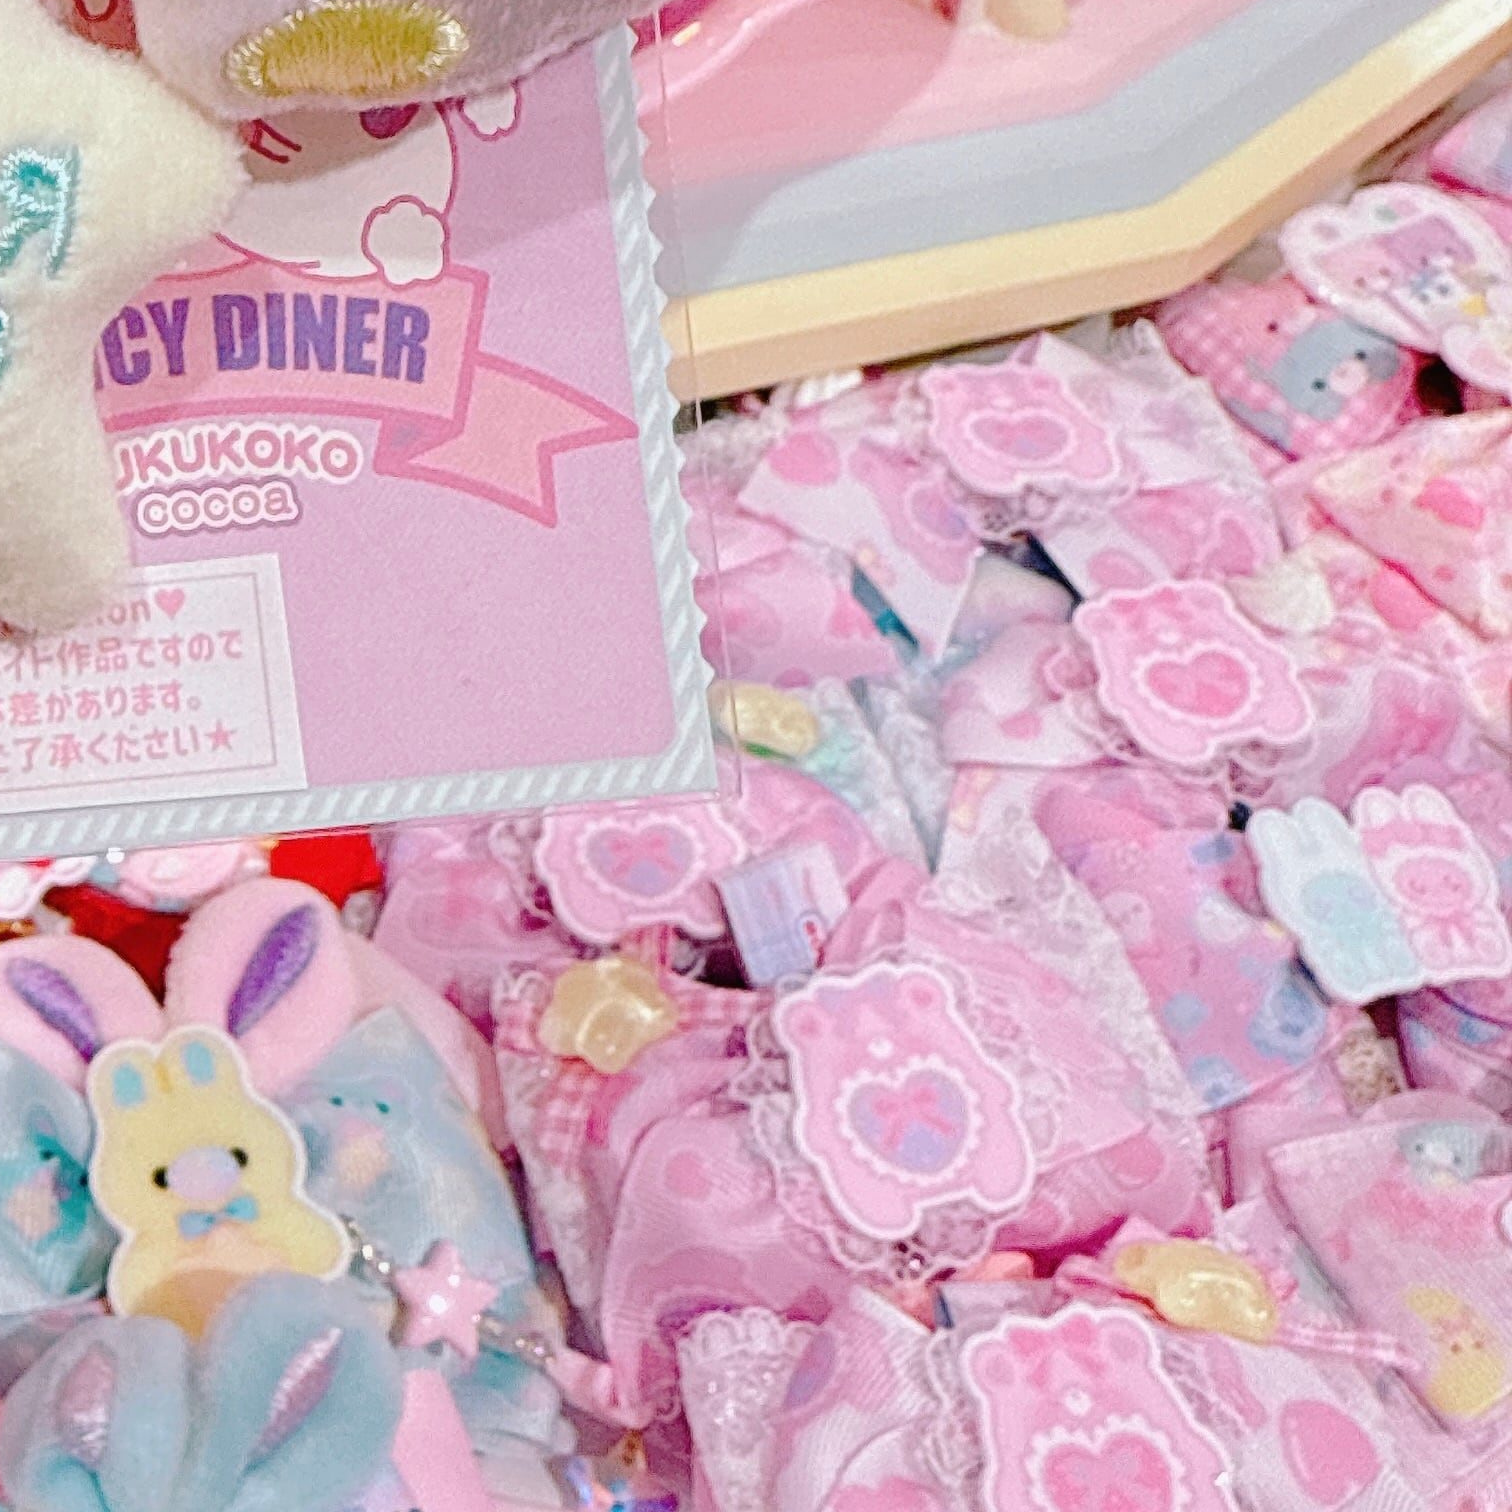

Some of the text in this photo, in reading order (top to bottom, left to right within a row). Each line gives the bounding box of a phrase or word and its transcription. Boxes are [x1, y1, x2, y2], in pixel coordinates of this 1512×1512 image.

[94, 292, 432, 390] CY DINER
[142, 487, 292, 528] cocoa
